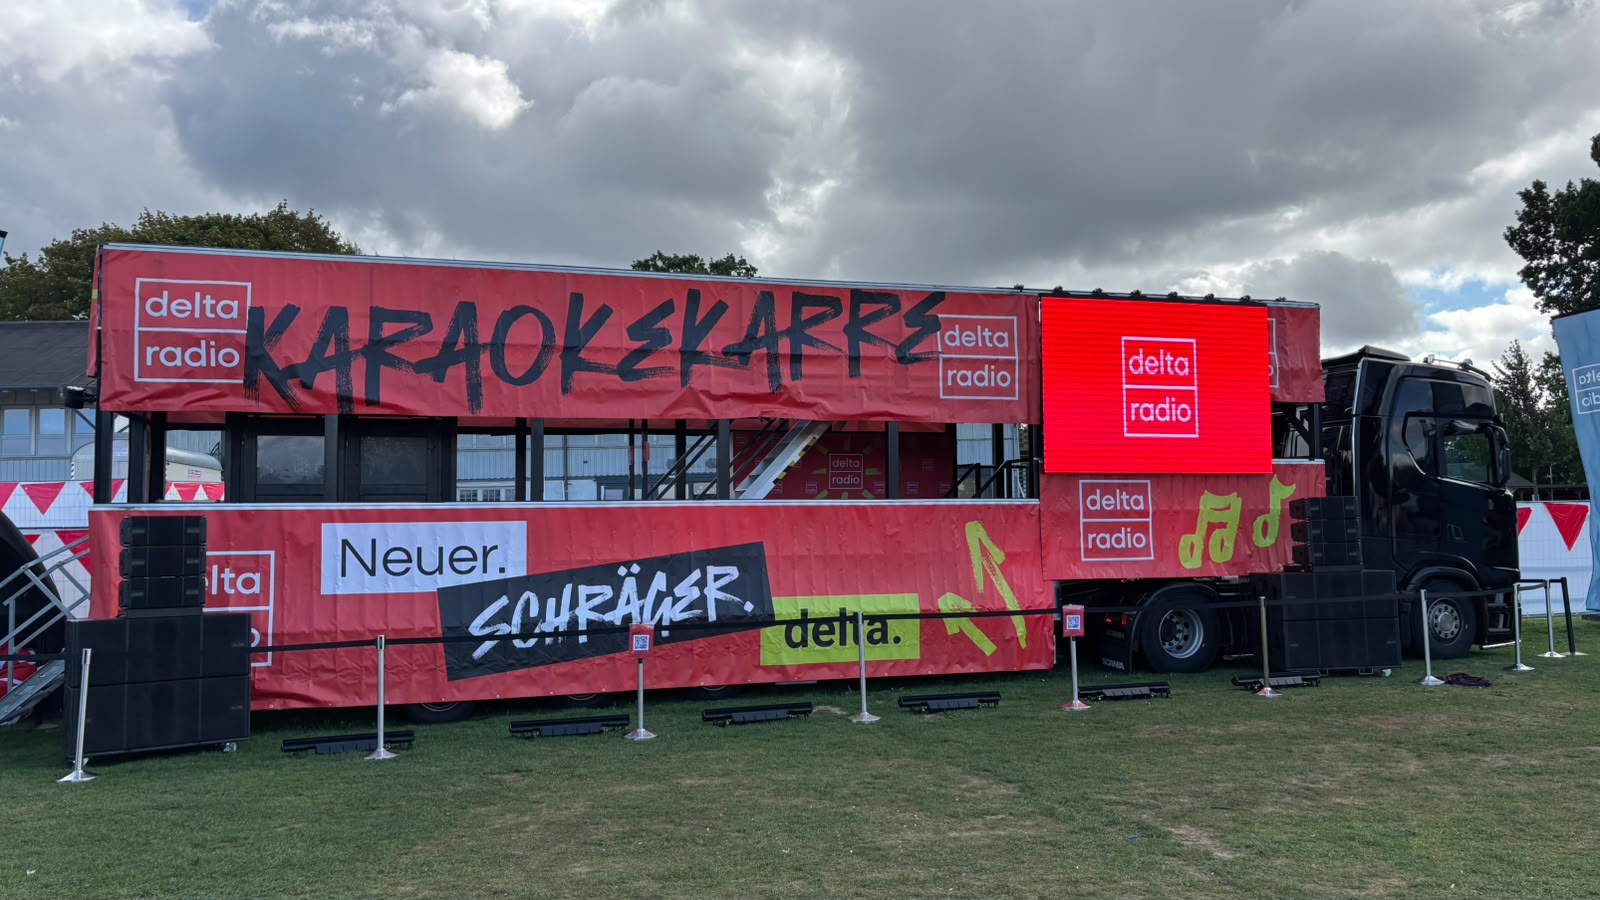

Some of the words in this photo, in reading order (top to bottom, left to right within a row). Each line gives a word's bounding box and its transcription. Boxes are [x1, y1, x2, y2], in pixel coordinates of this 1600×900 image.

[145, 290, 239, 320] delta
[944, 321, 1010, 349] delta
[145, 339, 241, 369] radio
[243, 288, 946, 414] KARAOKEKARRE
[1128, 348, 1190, 376] delta
[947, 362, 1012, 388] radio
[1130, 396, 1192, 423] radio
[831, 457, 861, 468] delta
[831, 473, 861, 485] radio
[1086, 489, 1145, 511] delta
[1088, 527, 1147, 549] radio
[340, 537, 507, 578] Neuer.
[204, 564, 261, 595] lta
[468, 562, 755, 661] SCHRÄGER.
[784, 607, 902, 649] delta.
